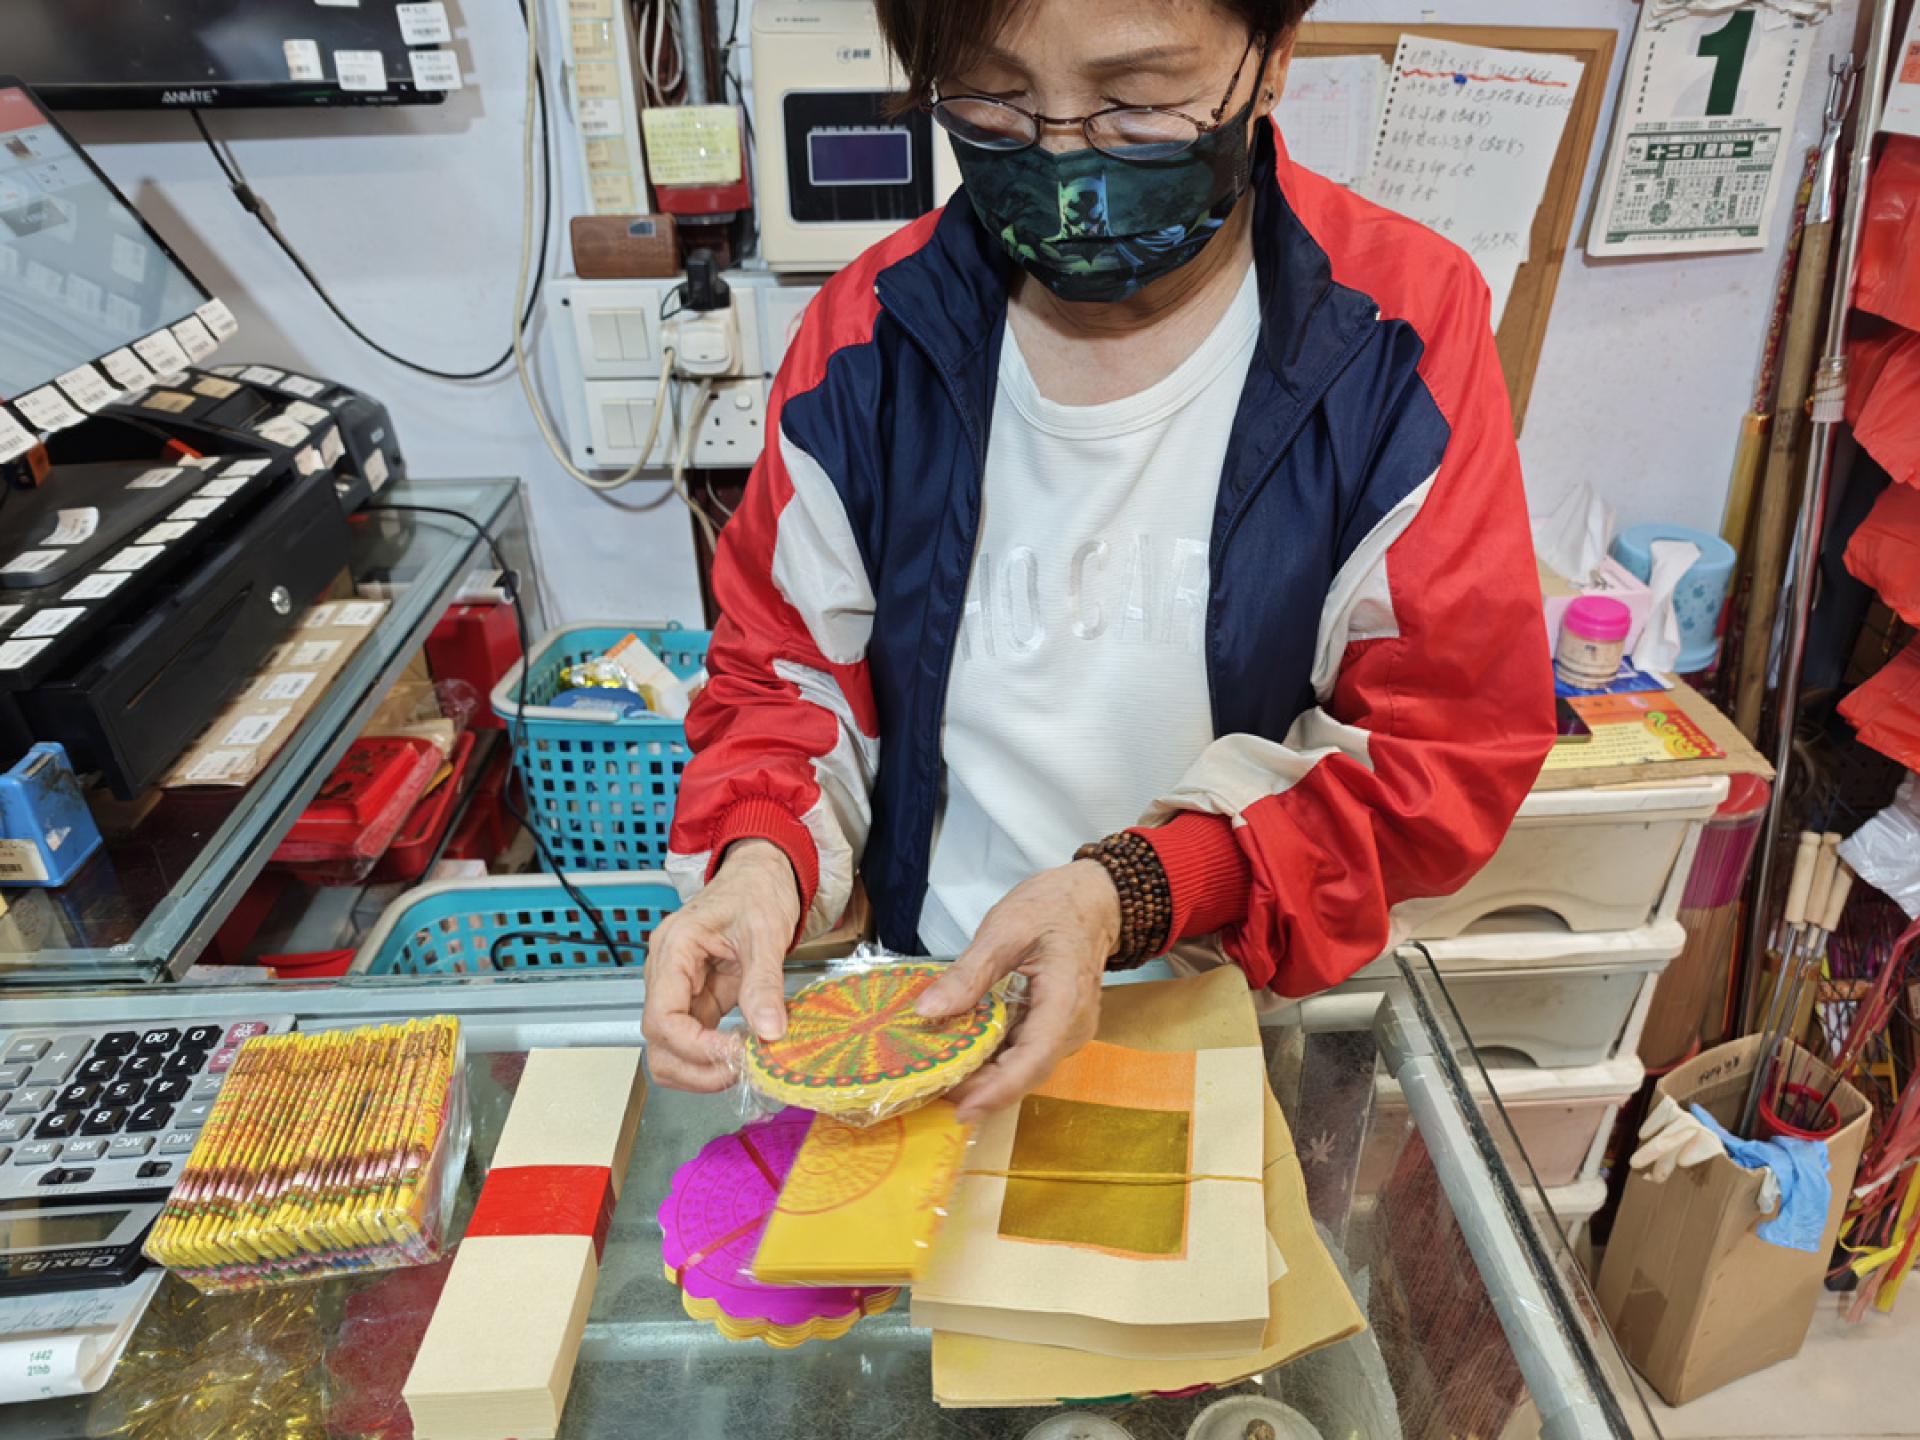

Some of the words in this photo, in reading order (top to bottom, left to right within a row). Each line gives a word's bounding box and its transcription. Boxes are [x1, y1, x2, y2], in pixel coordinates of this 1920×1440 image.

[1696, 9, 1756, 116] 1
[144, 1032, 169, 1044] 00
[191, 1030, 207, 1041] 0
[88, 1060, 107, 1073] 3
[132, 1057, 147, 1069] 2
[177, 1054, 189, 1067] 1
[69, 1086, 87, 1100] 6
[113, 1083, 130, 1096] 5
[157, 1080, 172, 1093] 4
[48, 1114, 66, 1127] 9
[94, 1110, 112, 1123] 8
[139, 1107, 152, 1121] 7
